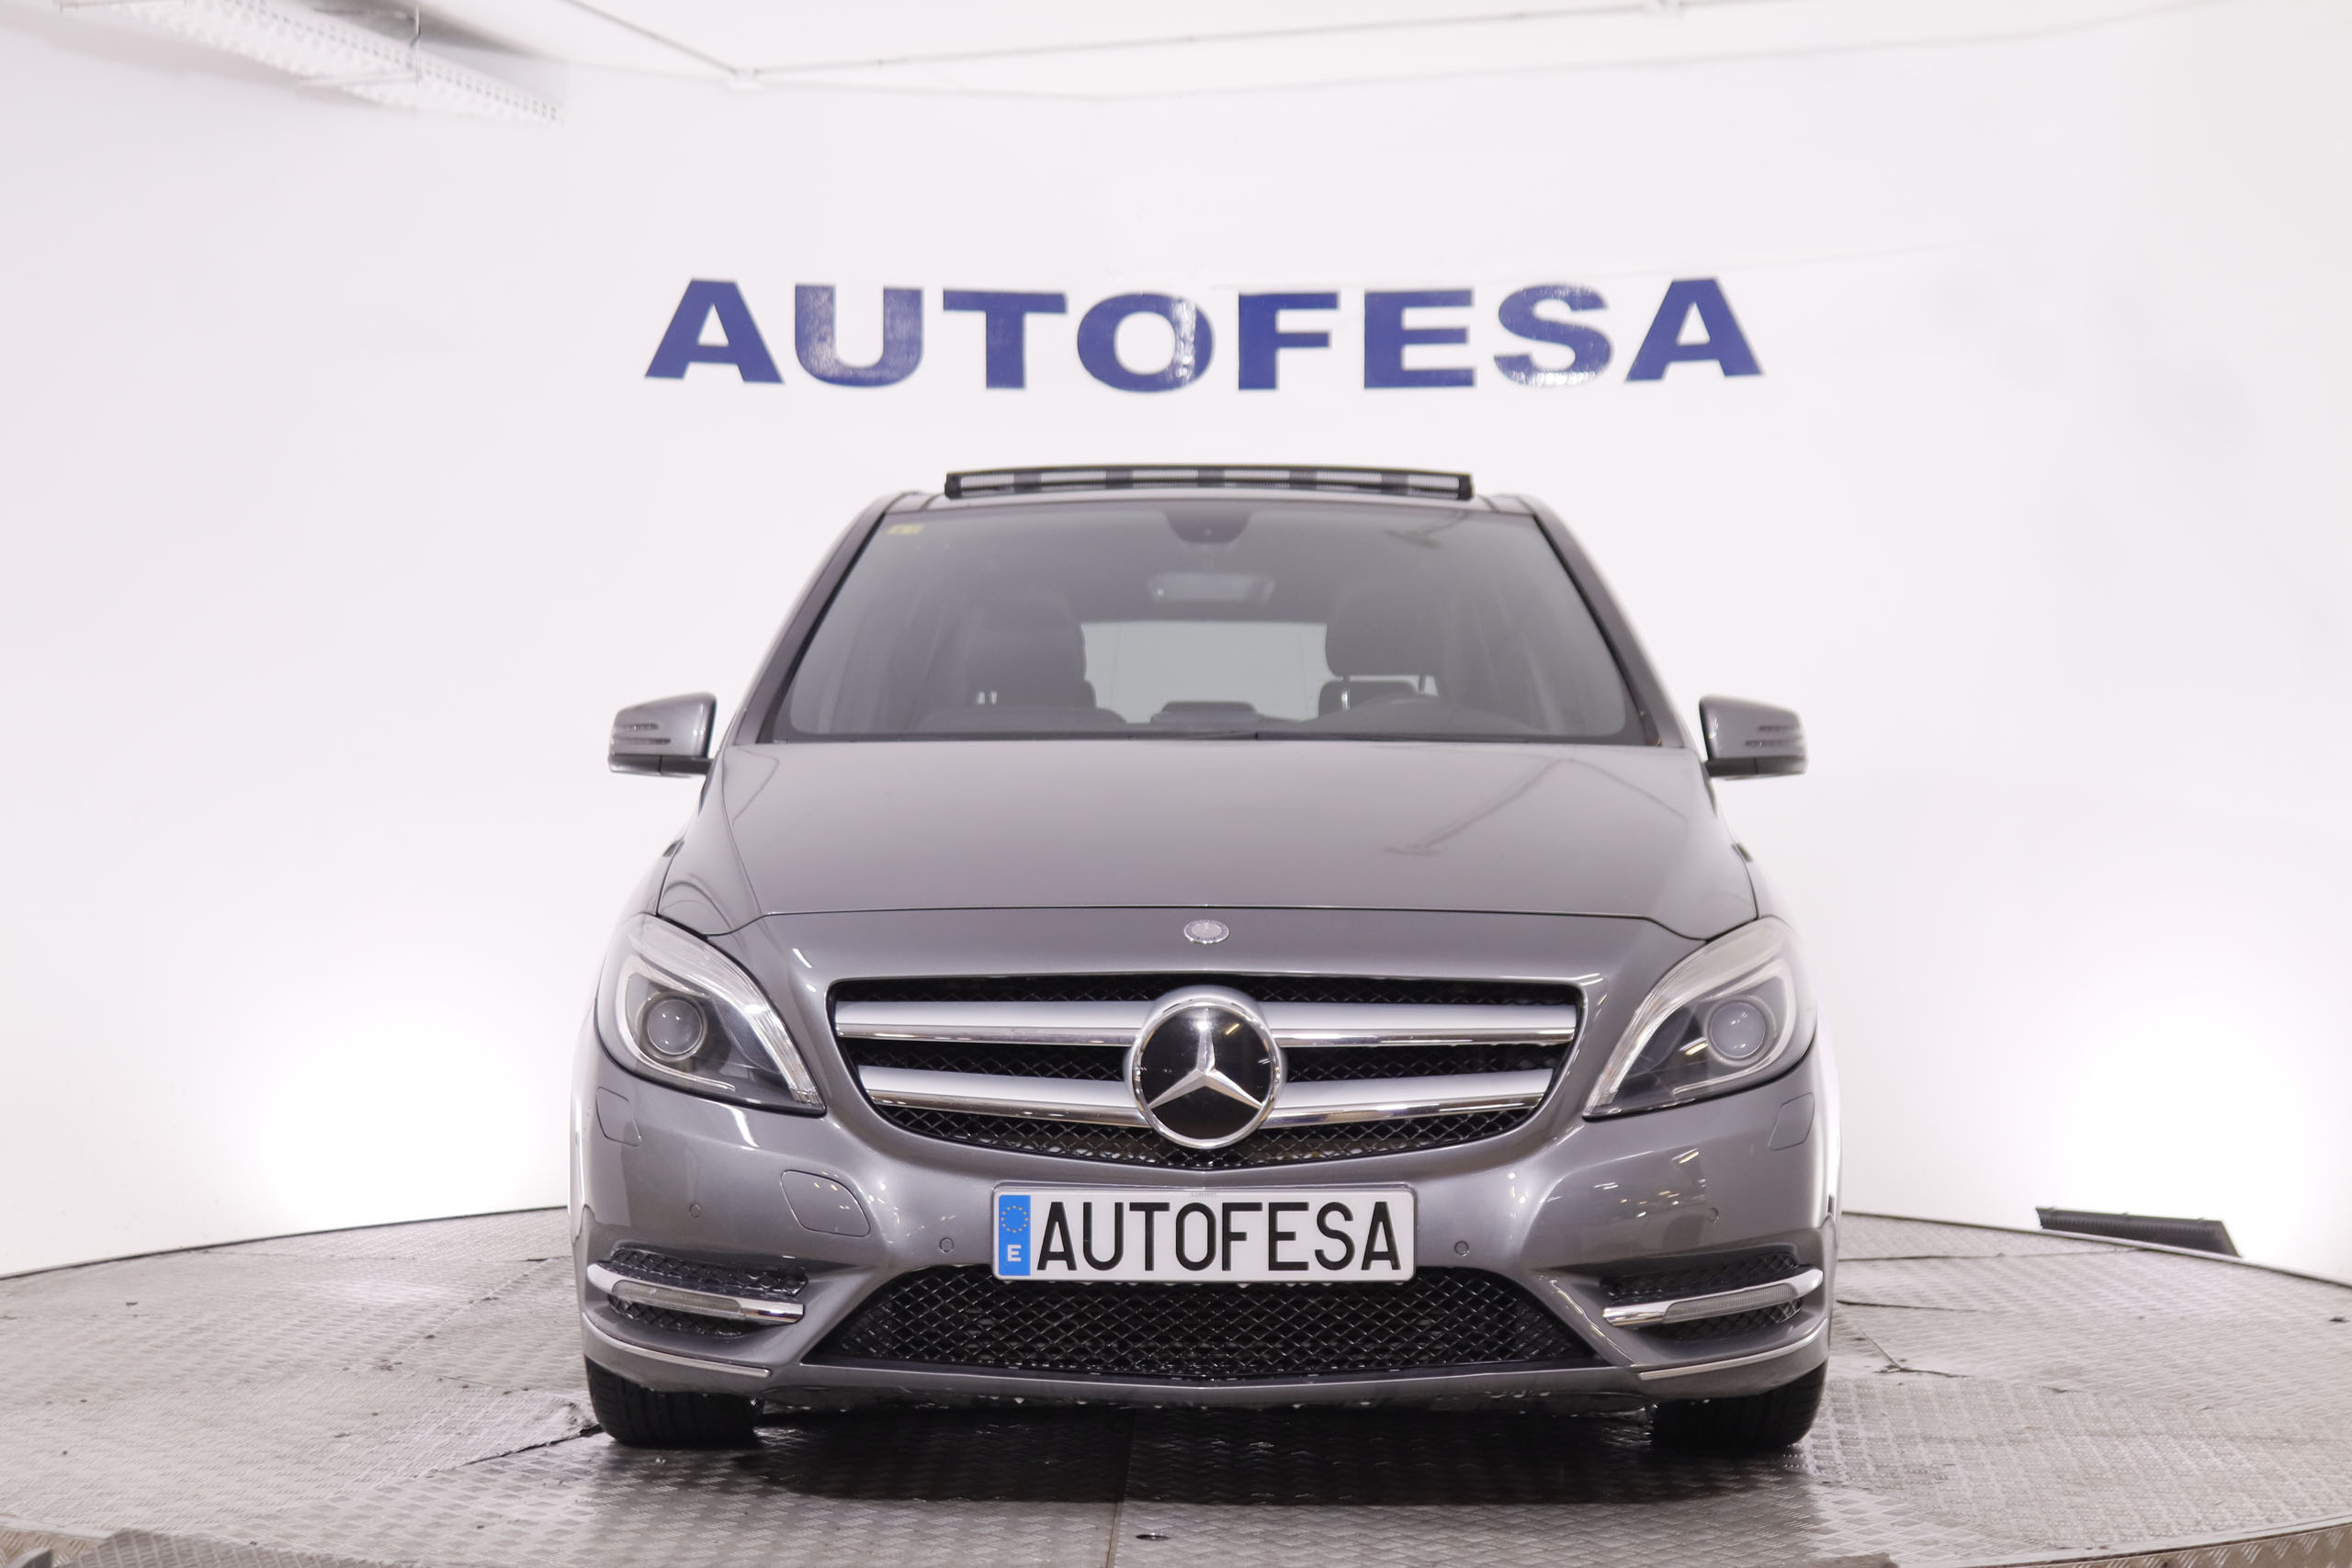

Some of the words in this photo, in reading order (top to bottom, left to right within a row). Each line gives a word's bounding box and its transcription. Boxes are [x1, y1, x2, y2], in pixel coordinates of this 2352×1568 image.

[645, 278, 1762, 393] AUTOFESA
[1007, 1244, 1022, 1262] E
[1036, 1201, 1402, 1271] AUTOFESA
